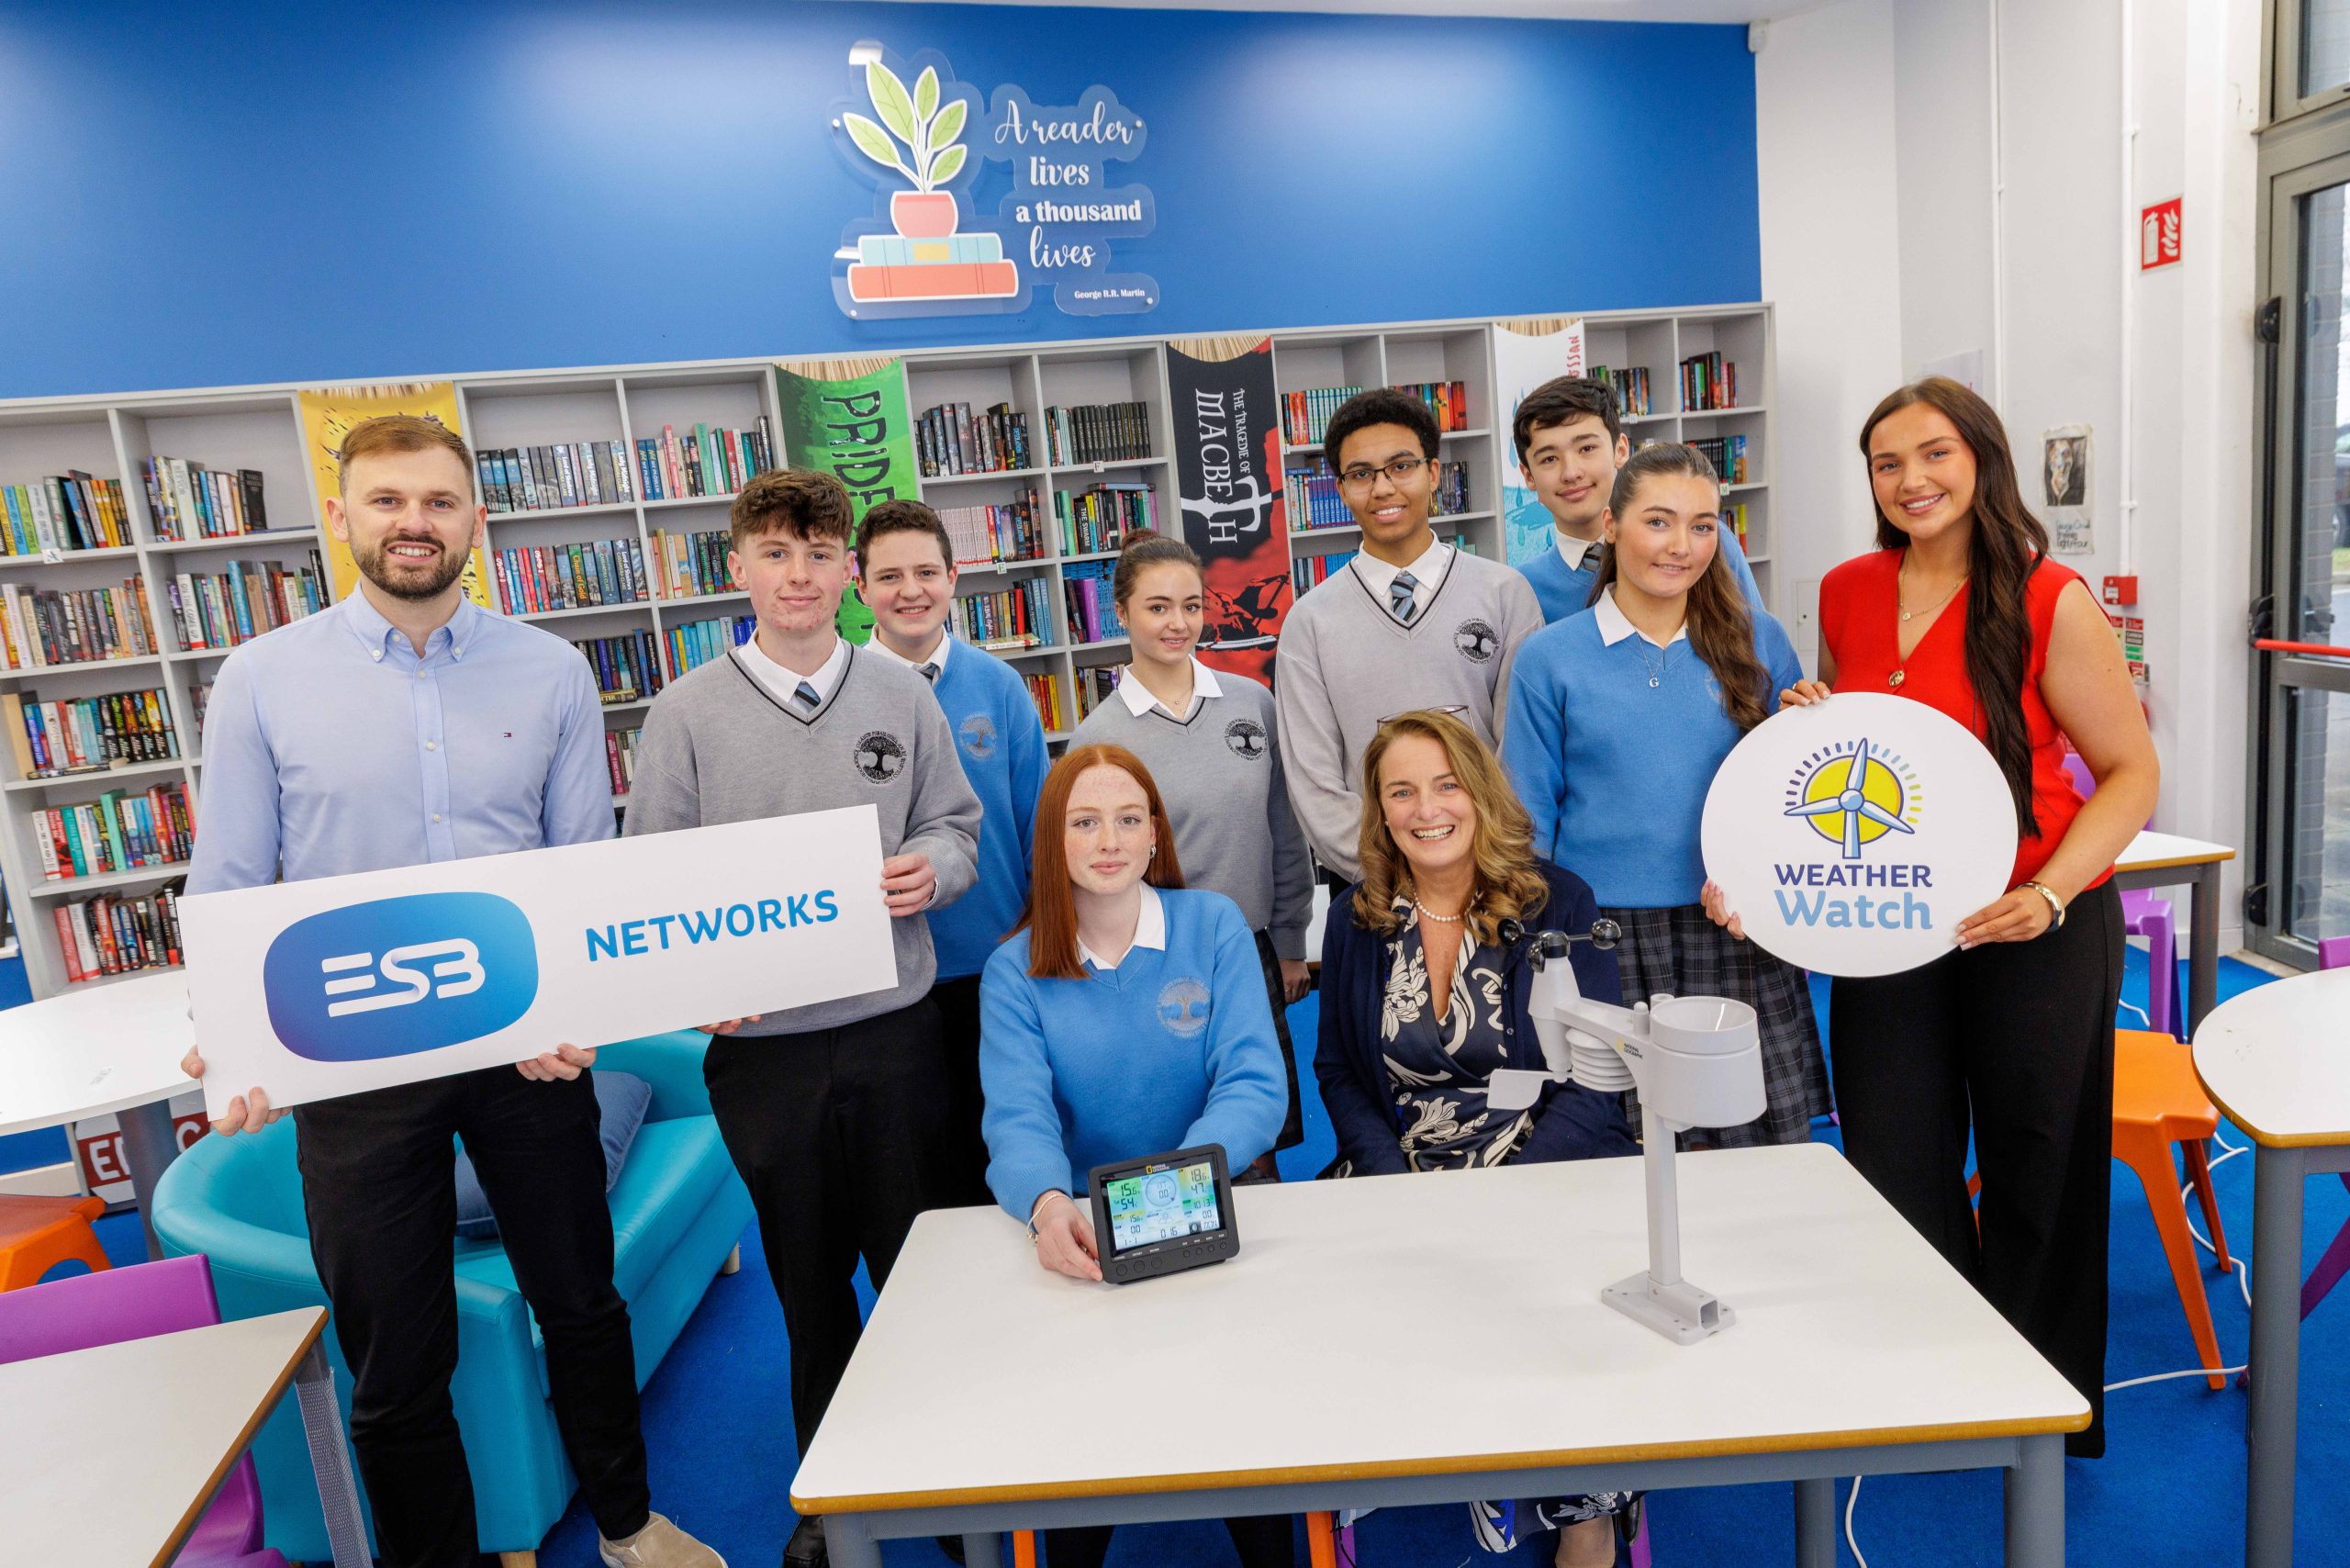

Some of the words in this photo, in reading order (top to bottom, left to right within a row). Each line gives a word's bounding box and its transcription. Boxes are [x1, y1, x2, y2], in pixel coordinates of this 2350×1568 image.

[995, 100, 1028, 144] A
[1033, 101, 1134, 144] reader
[1030, 156, 1090, 185] lives
[1016, 206, 1031, 222] a
[1035, 200, 1141, 222] thousand
[1030, 226, 1095, 268] lives
[1075, 290, 1102, 298] George
[1103, 289, 1119, 297] R.R.
[1121, 288, 1145, 297] Martin
[1233, 388, 1245, 411] THE
[822, 390, 895, 505] PRIDE
[1235, 411, 1249, 458] TRAGEDIE
[1195, 388, 1260, 543] MACBETH
[1239, 459, 1250, 474] OF
[1082, 522, 1091, 546] SWARM
[999, 565, 1005, 573] E
[1774, 864, 1932, 888] WEATHER
[585, 889, 839, 962] NETWORKS
[1774, 890, 1932, 930] Watch
[320, 937, 487, 1018] ESB
